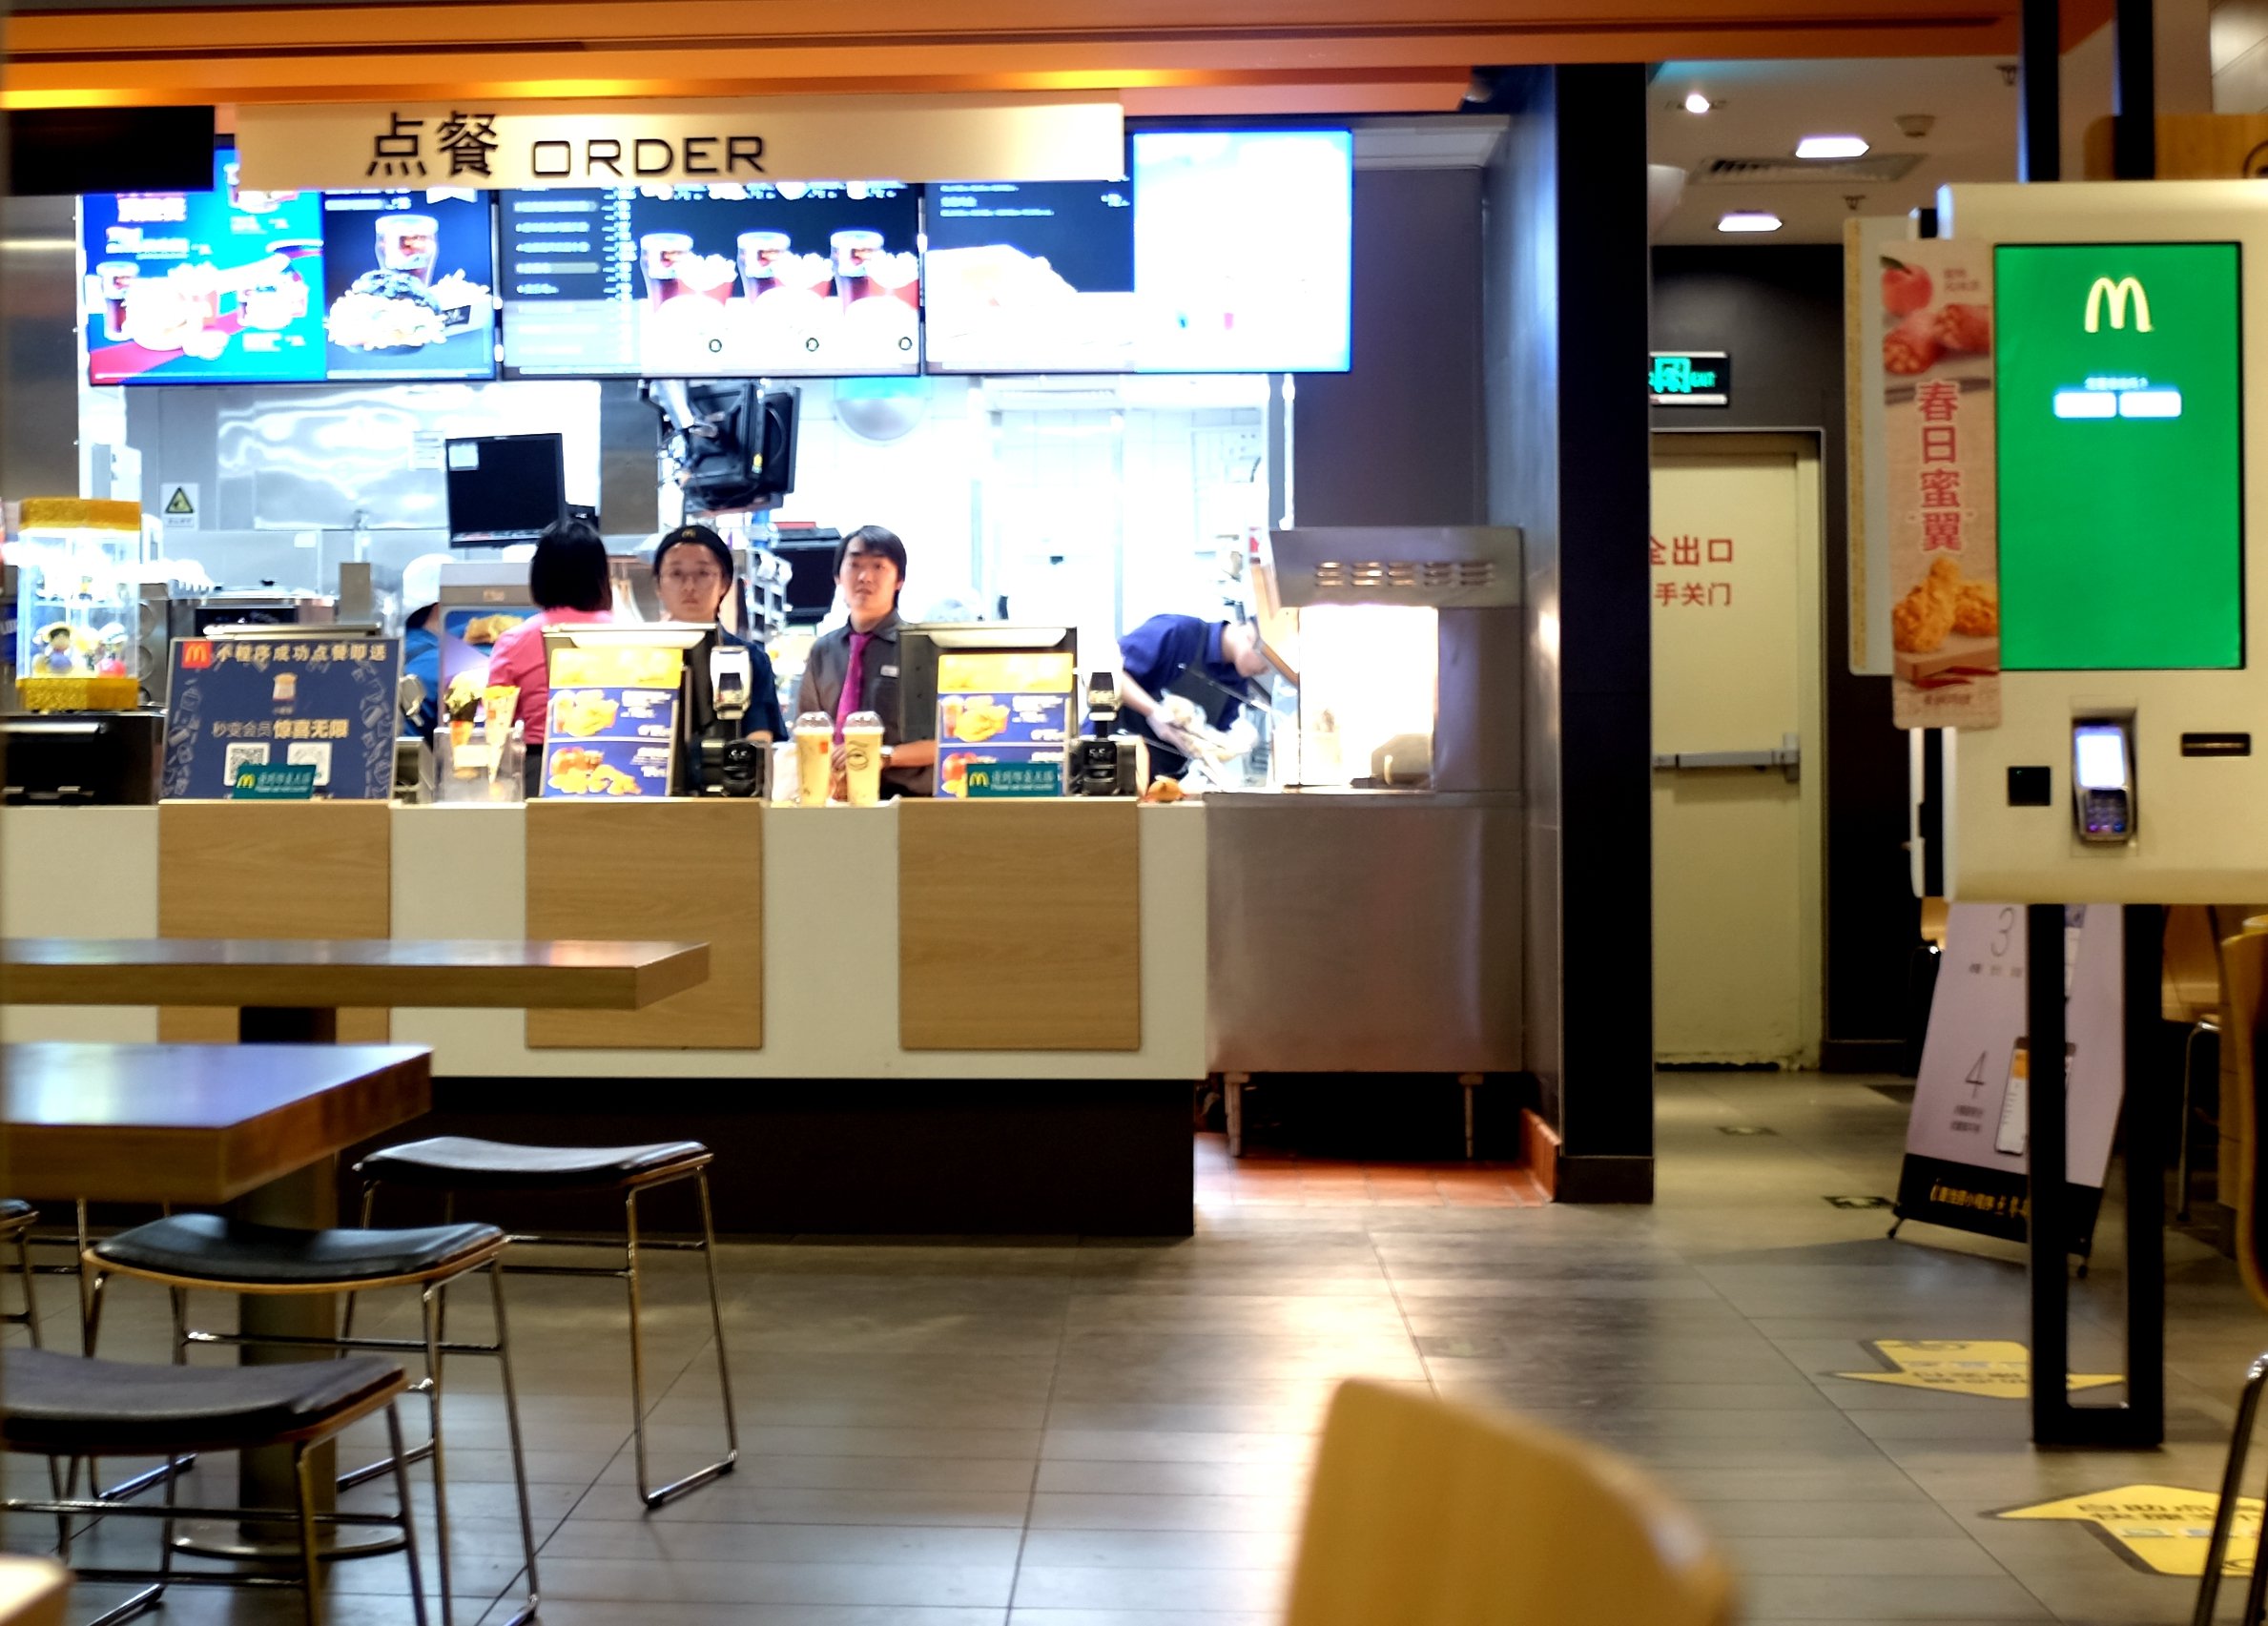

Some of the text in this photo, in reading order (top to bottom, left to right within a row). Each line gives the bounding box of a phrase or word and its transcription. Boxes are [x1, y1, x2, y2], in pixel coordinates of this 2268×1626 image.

[366, 111, 498, 176] 点餐
[532, 135, 766, 177] ORDER
[1918, 381, 1963, 551] 春日蜜翼
[1654, 583, 1732, 607] 手关门
[1990, 907, 2014, 957] 3
[1965, 1051, 1987, 1100] 4
